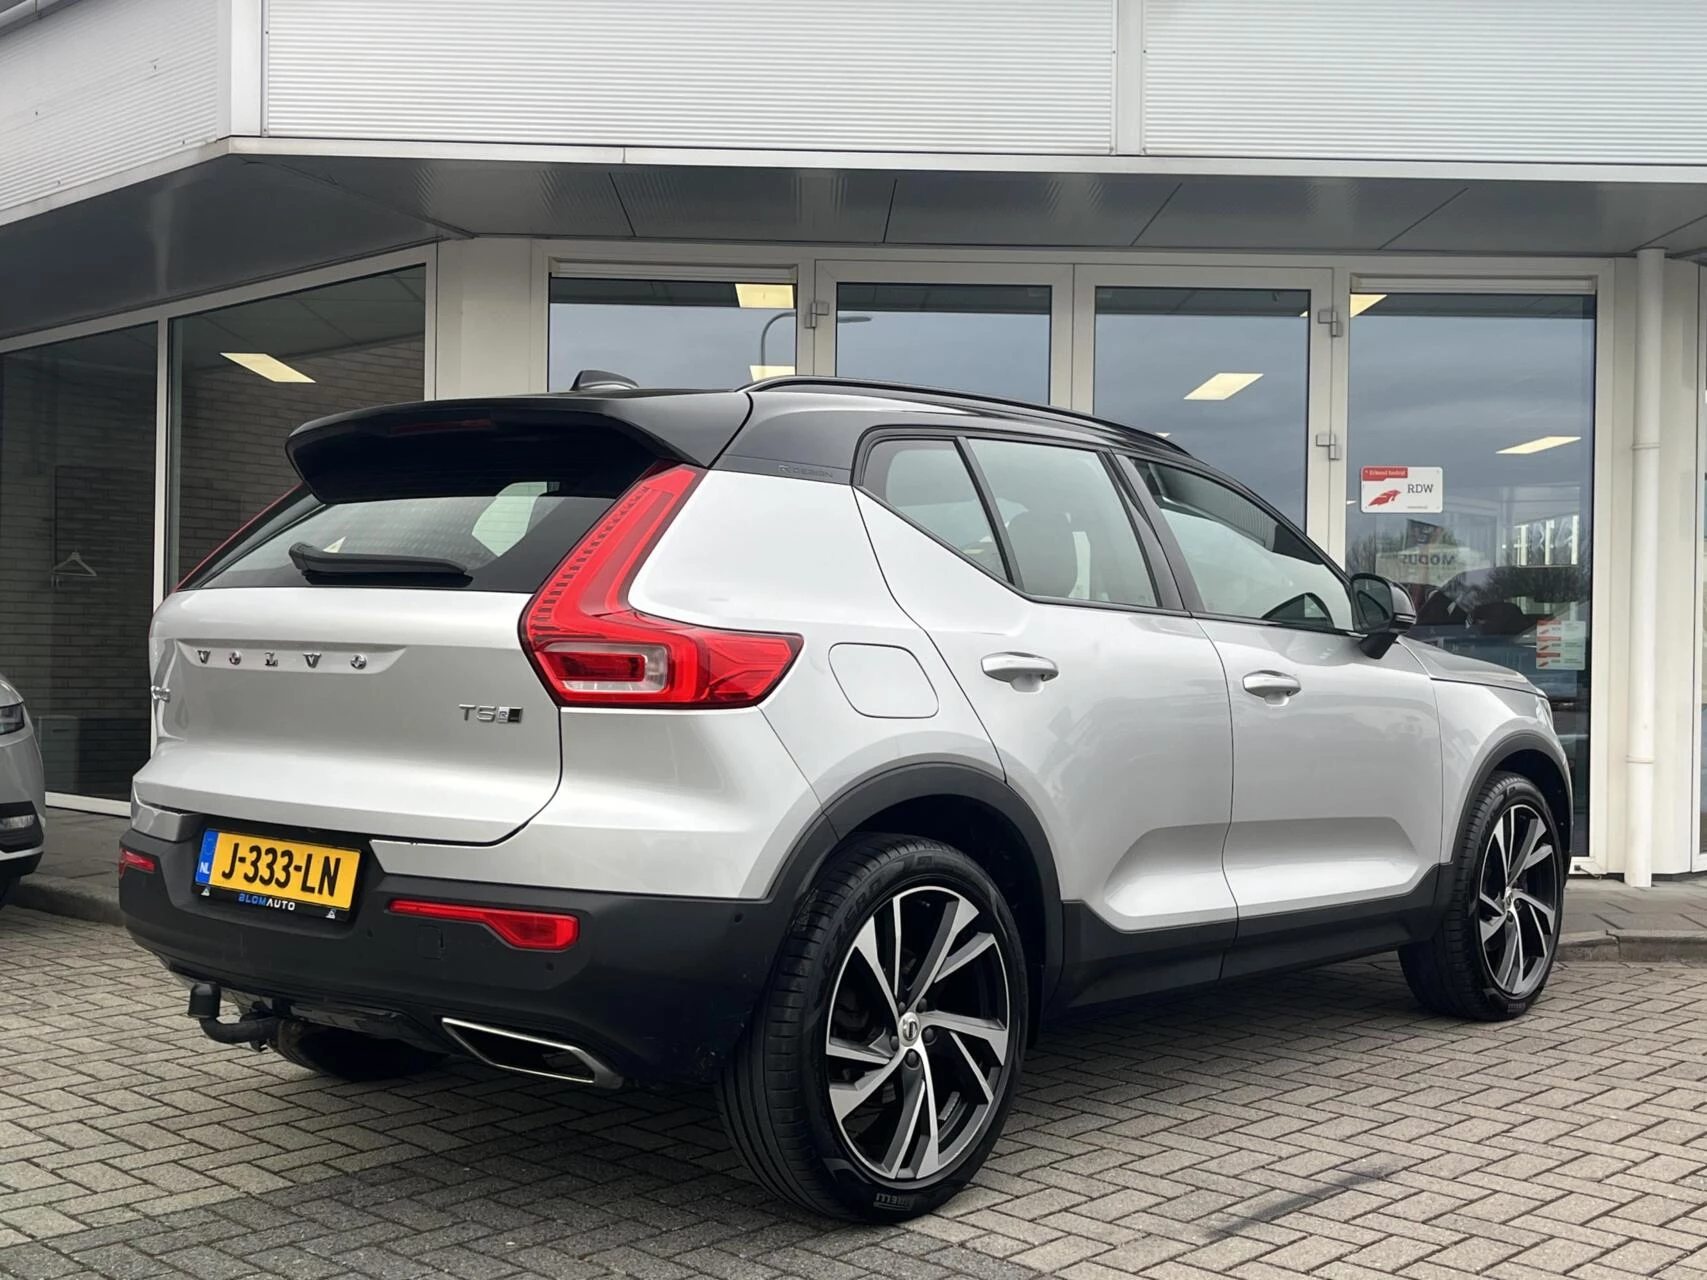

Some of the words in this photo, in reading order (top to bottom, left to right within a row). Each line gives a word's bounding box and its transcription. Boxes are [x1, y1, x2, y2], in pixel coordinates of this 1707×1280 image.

[1407, 483, 1434, 494] RDW
[197, 650, 368, 670] VOLVO
[459, 704, 497, 722] T5
[199, 861, 210, 875] NL
[222, 843, 341, 897] J-333-LN
[238, 893, 296, 911] BLOMAUTO
